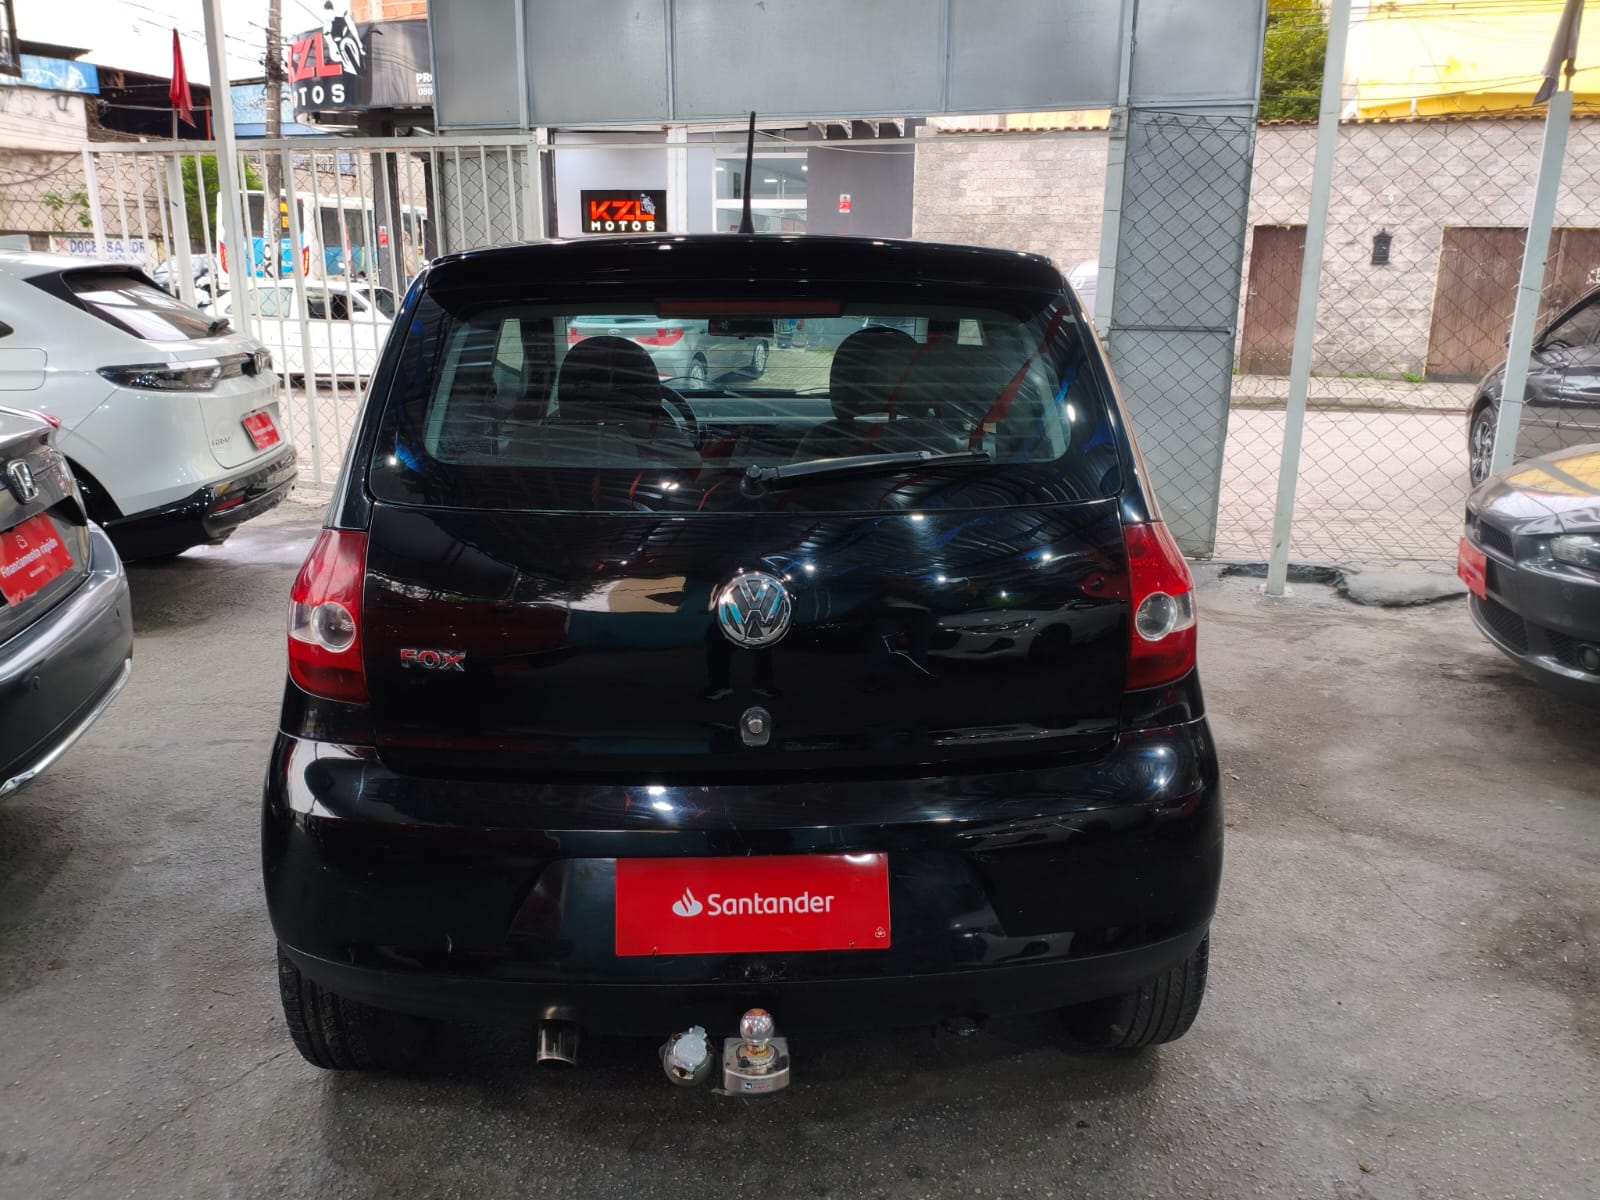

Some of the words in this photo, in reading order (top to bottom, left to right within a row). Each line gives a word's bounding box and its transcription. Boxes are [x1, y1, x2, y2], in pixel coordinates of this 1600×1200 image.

[415, 72, 433, 83] PR
[590, 200, 655, 221] KZL
[591, 220, 655, 231] MOTOS
[400, 648, 467, 672] FOX
[707, 891, 834, 916] Santander
